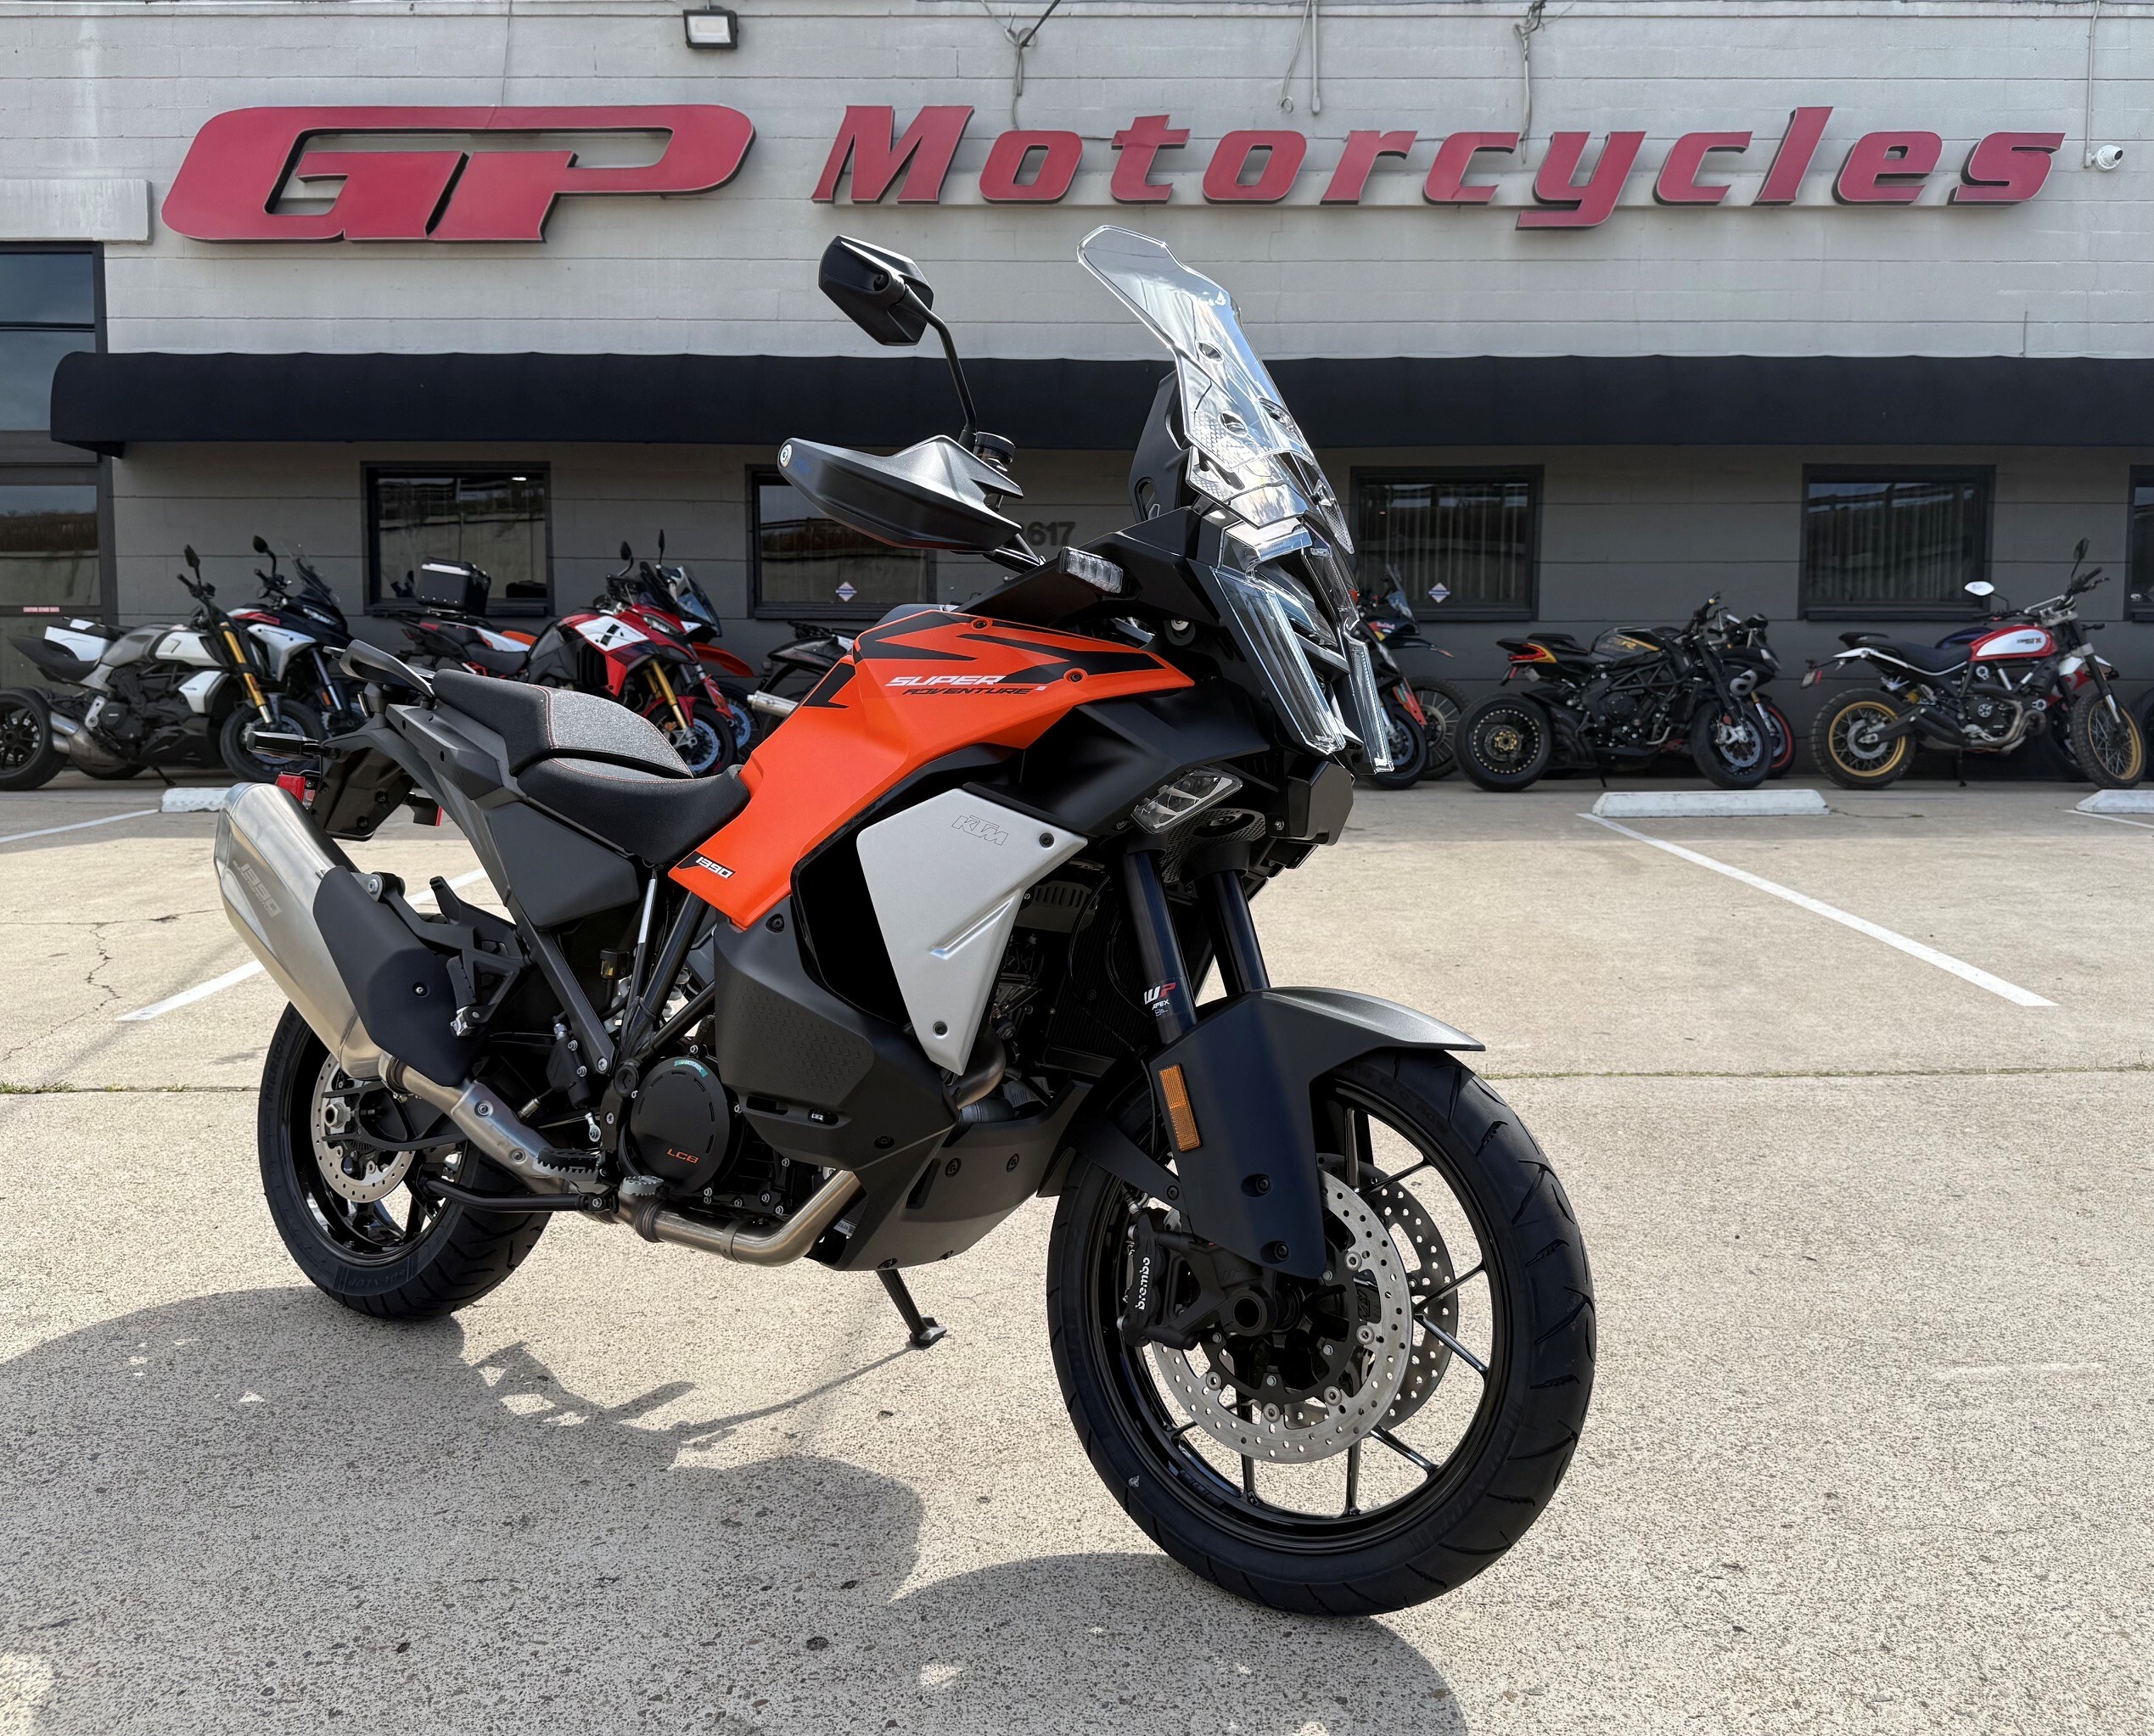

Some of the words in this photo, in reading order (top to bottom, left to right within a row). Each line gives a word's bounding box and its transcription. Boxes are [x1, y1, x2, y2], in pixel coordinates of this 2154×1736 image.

[161, 104, 757, 244] GP
[811, 105, 2066, 231] Motorcycles
[884, 675, 1007, 687] SUPER
[951, 815, 1009, 846] KTM
[695, 856, 733, 879] 1390
[241, 863, 283, 916] 1390
[1143, 982, 1177, 1005] WP
[1152, 999, 1170, 1011] APEX
[667, 1148, 699, 1164] LC8
[1135, 1256, 1151, 1311] brembo
